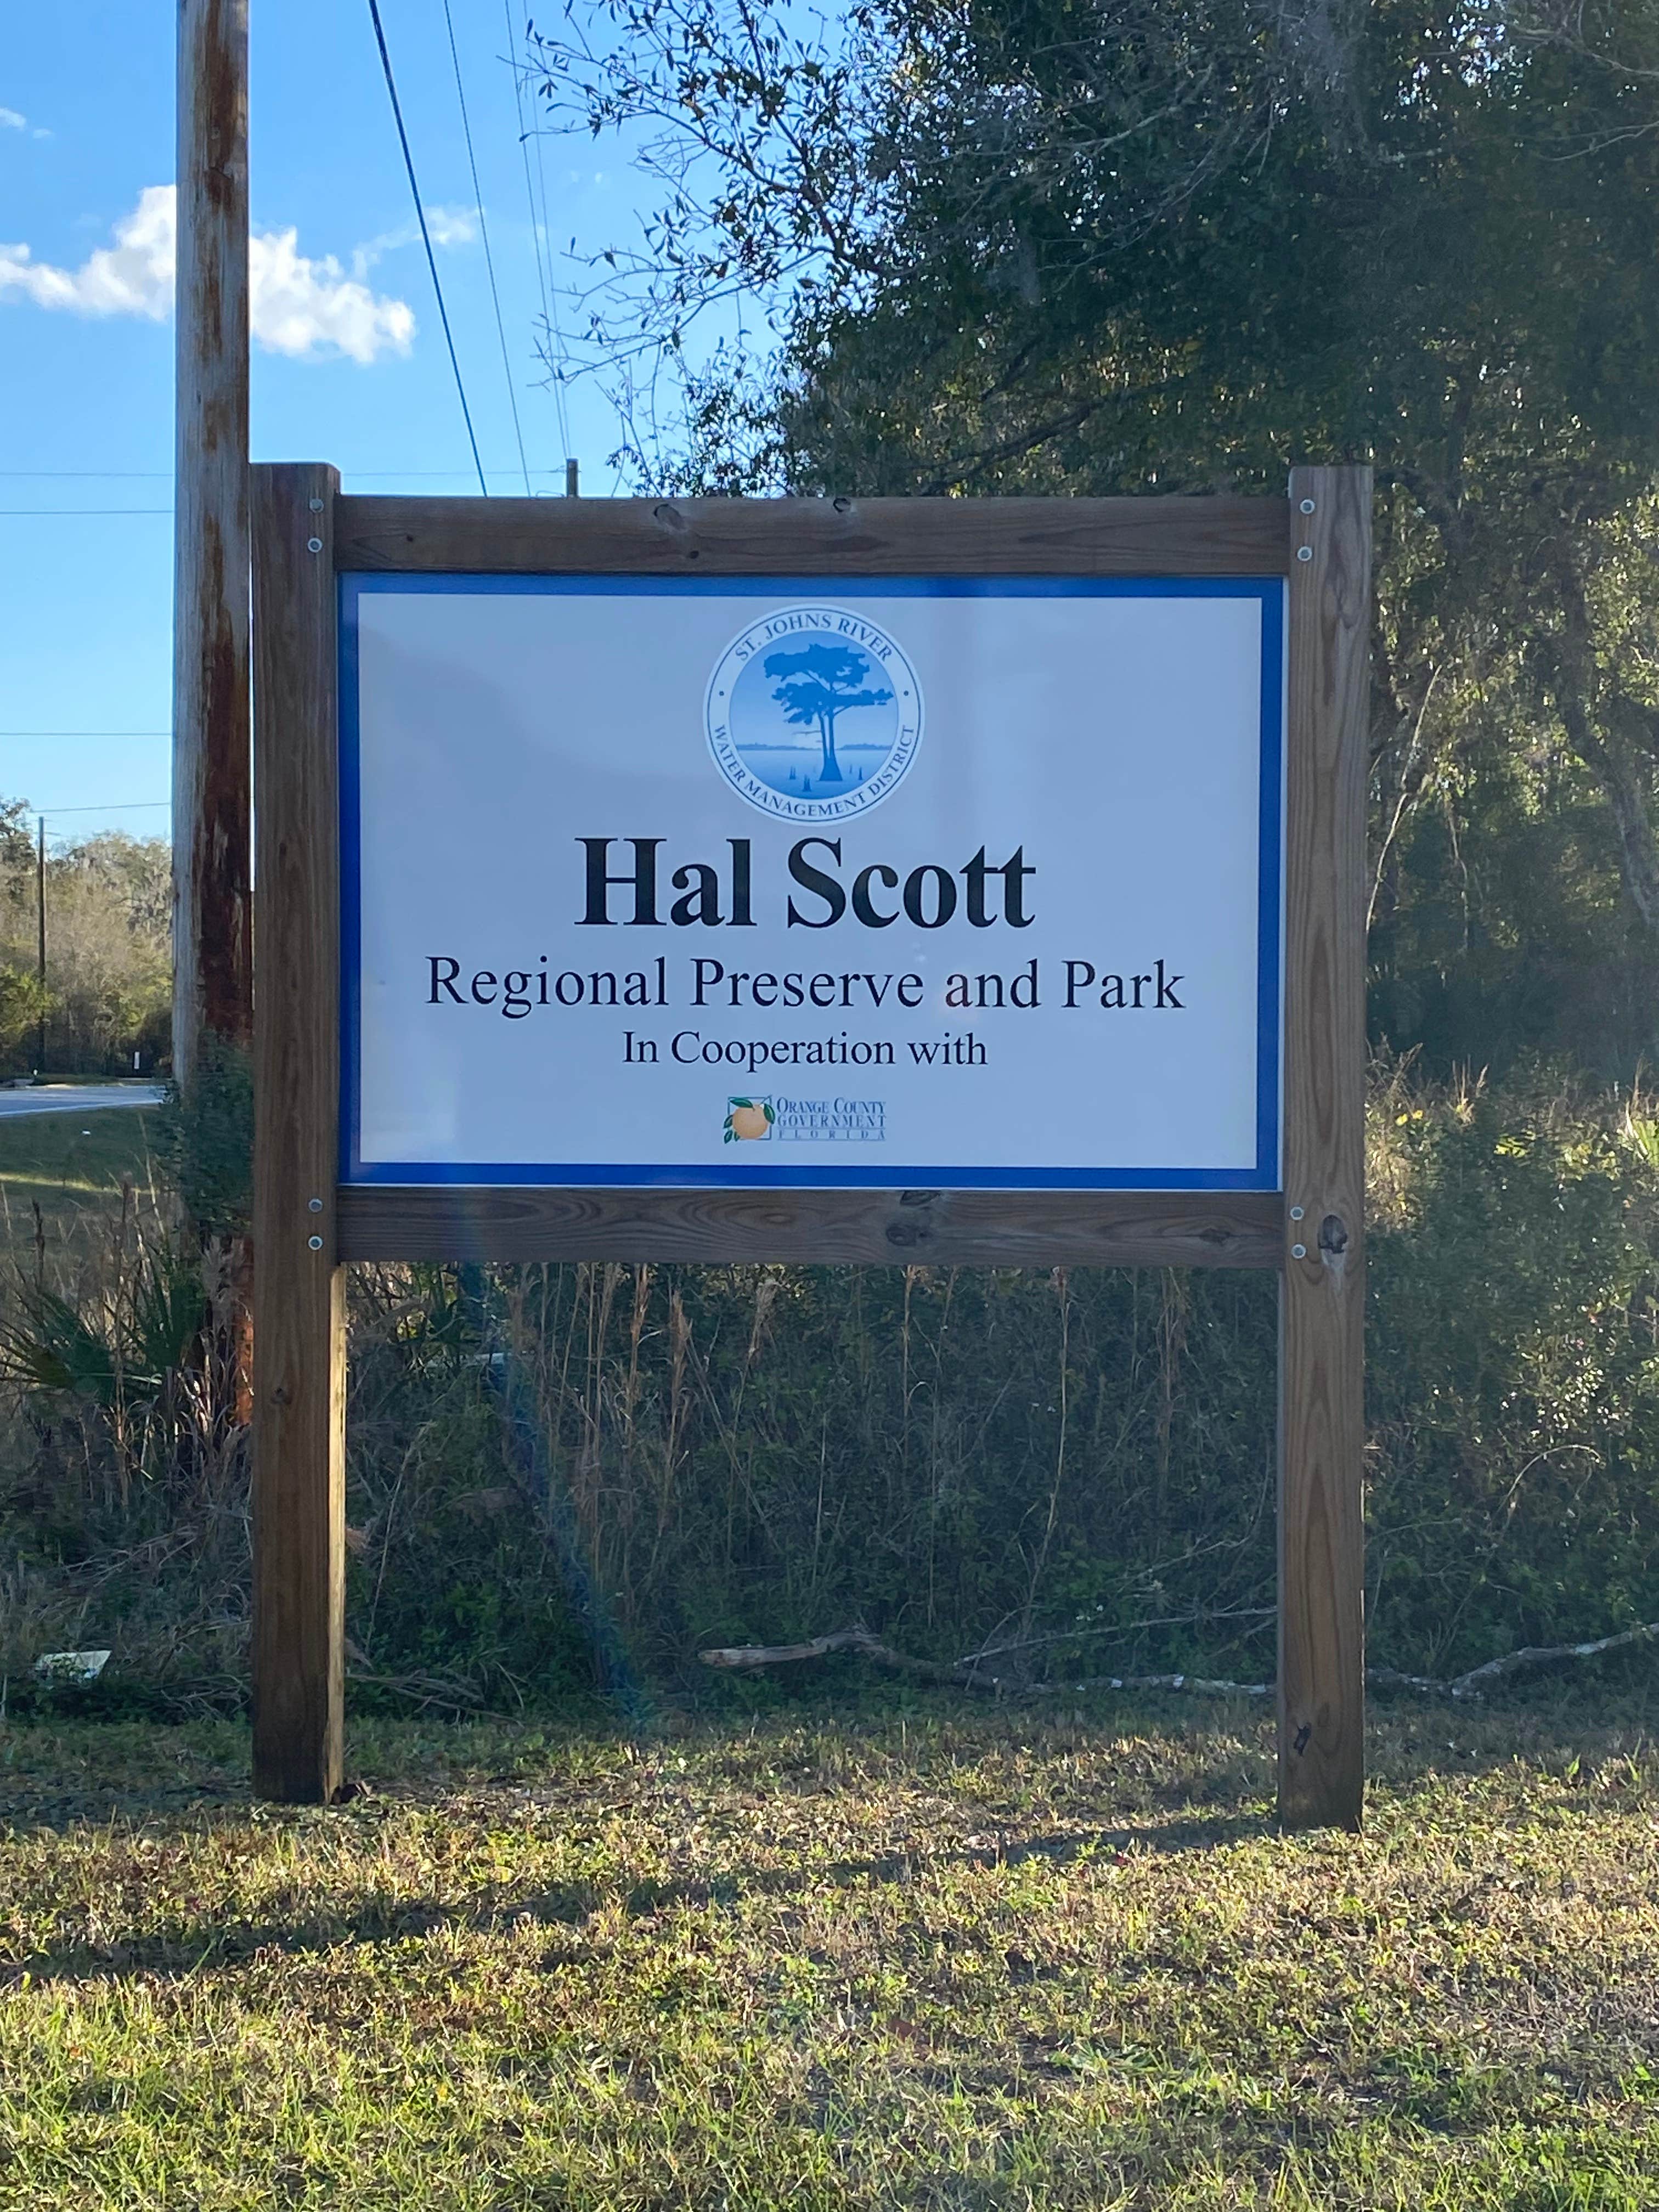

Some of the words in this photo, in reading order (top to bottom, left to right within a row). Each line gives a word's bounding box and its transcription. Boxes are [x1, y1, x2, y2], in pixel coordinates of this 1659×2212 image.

[736, 637, 763, 662] ST.
[765, 613, 832, 641] JOHNS
[837, 617, 893, 662] RIVER
[714, 725, 747, 782] WATER
[744, 779, 866, 817] MANAGEMENT
[867, 725, 915, 797] DISTRICT
[574, 837, 758, 927] Hal
[787, 837, 1036, 929] Scott
[425, 955, 669, 1019] Regional
[690, 958, 923, 1008] Preserve
[945, 958, 1041, 1008] and
[1062, 959, 1186, 1008] Park
[623, 1031, 659, 1063] In
[672, 1031, 896, 1073] Cooperation
[907, 1032, 988, 1065] with
[777, 1114, 887, 1127] GOVERNMENT
